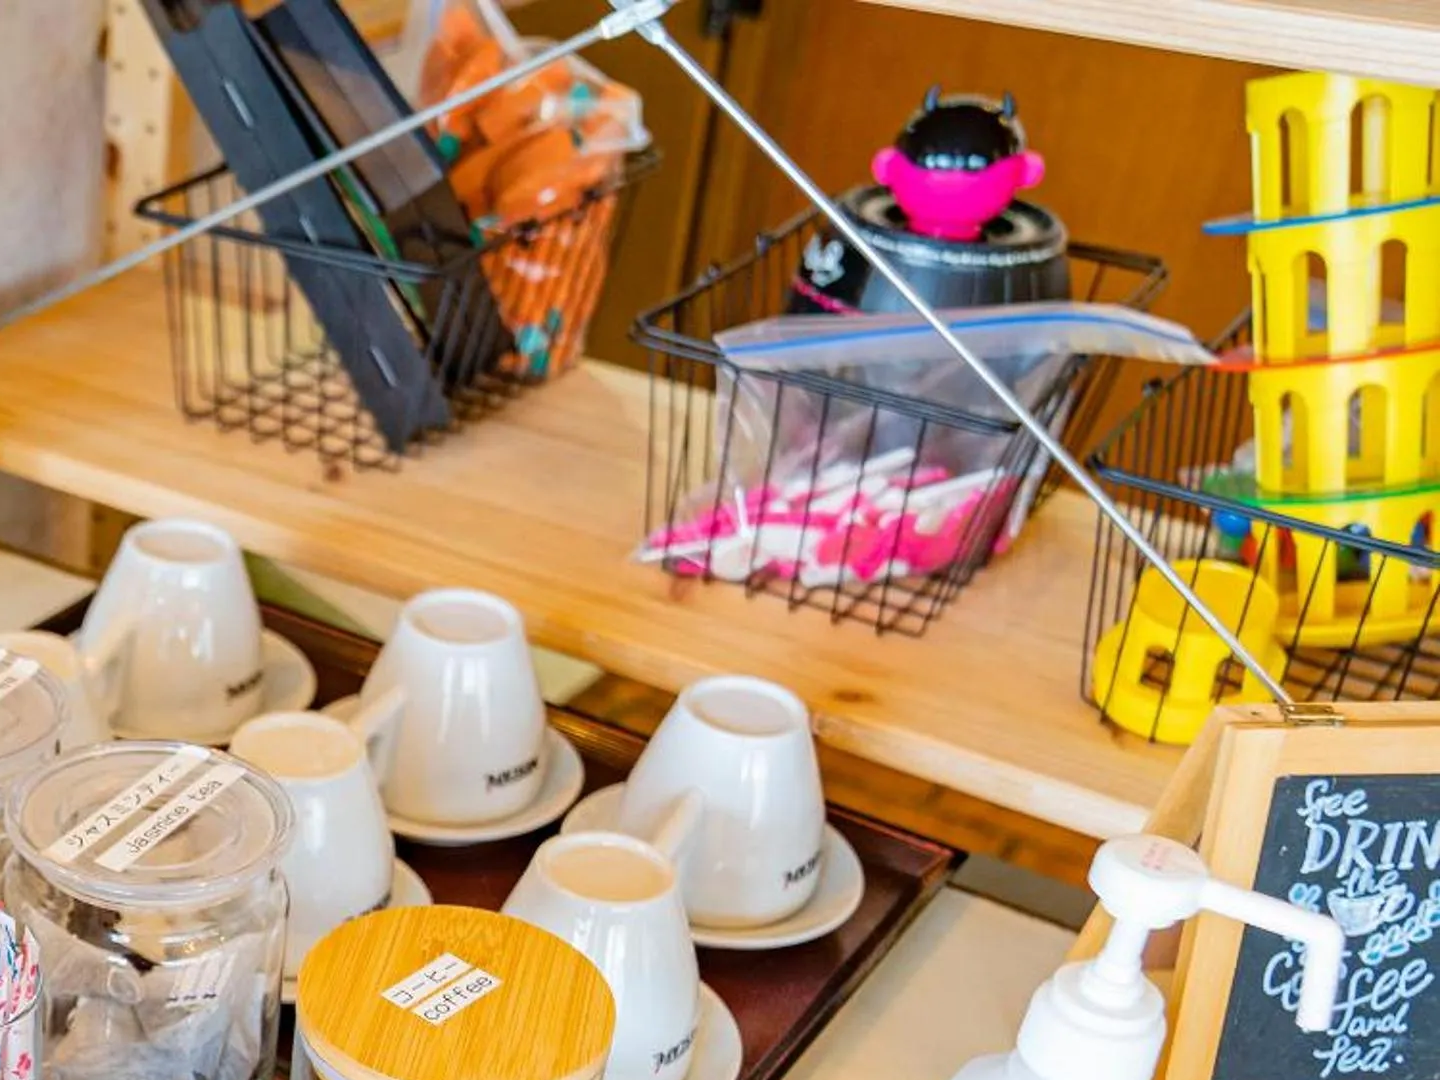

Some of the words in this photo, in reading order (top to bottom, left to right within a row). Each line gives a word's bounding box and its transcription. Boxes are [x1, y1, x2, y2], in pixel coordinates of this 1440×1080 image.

[65, 764, 181, 848] ジャスミンティー
[125, 805, 191, 855] Jasmine
[187, 779, 224, 802] tea
[391, 961, 459, 1005] コーヒー
[423, 975, 493, 1021] coffee
[1263, 952, 1435, 1036] Cofee
[1349, 1002, 1408, 1037] and
